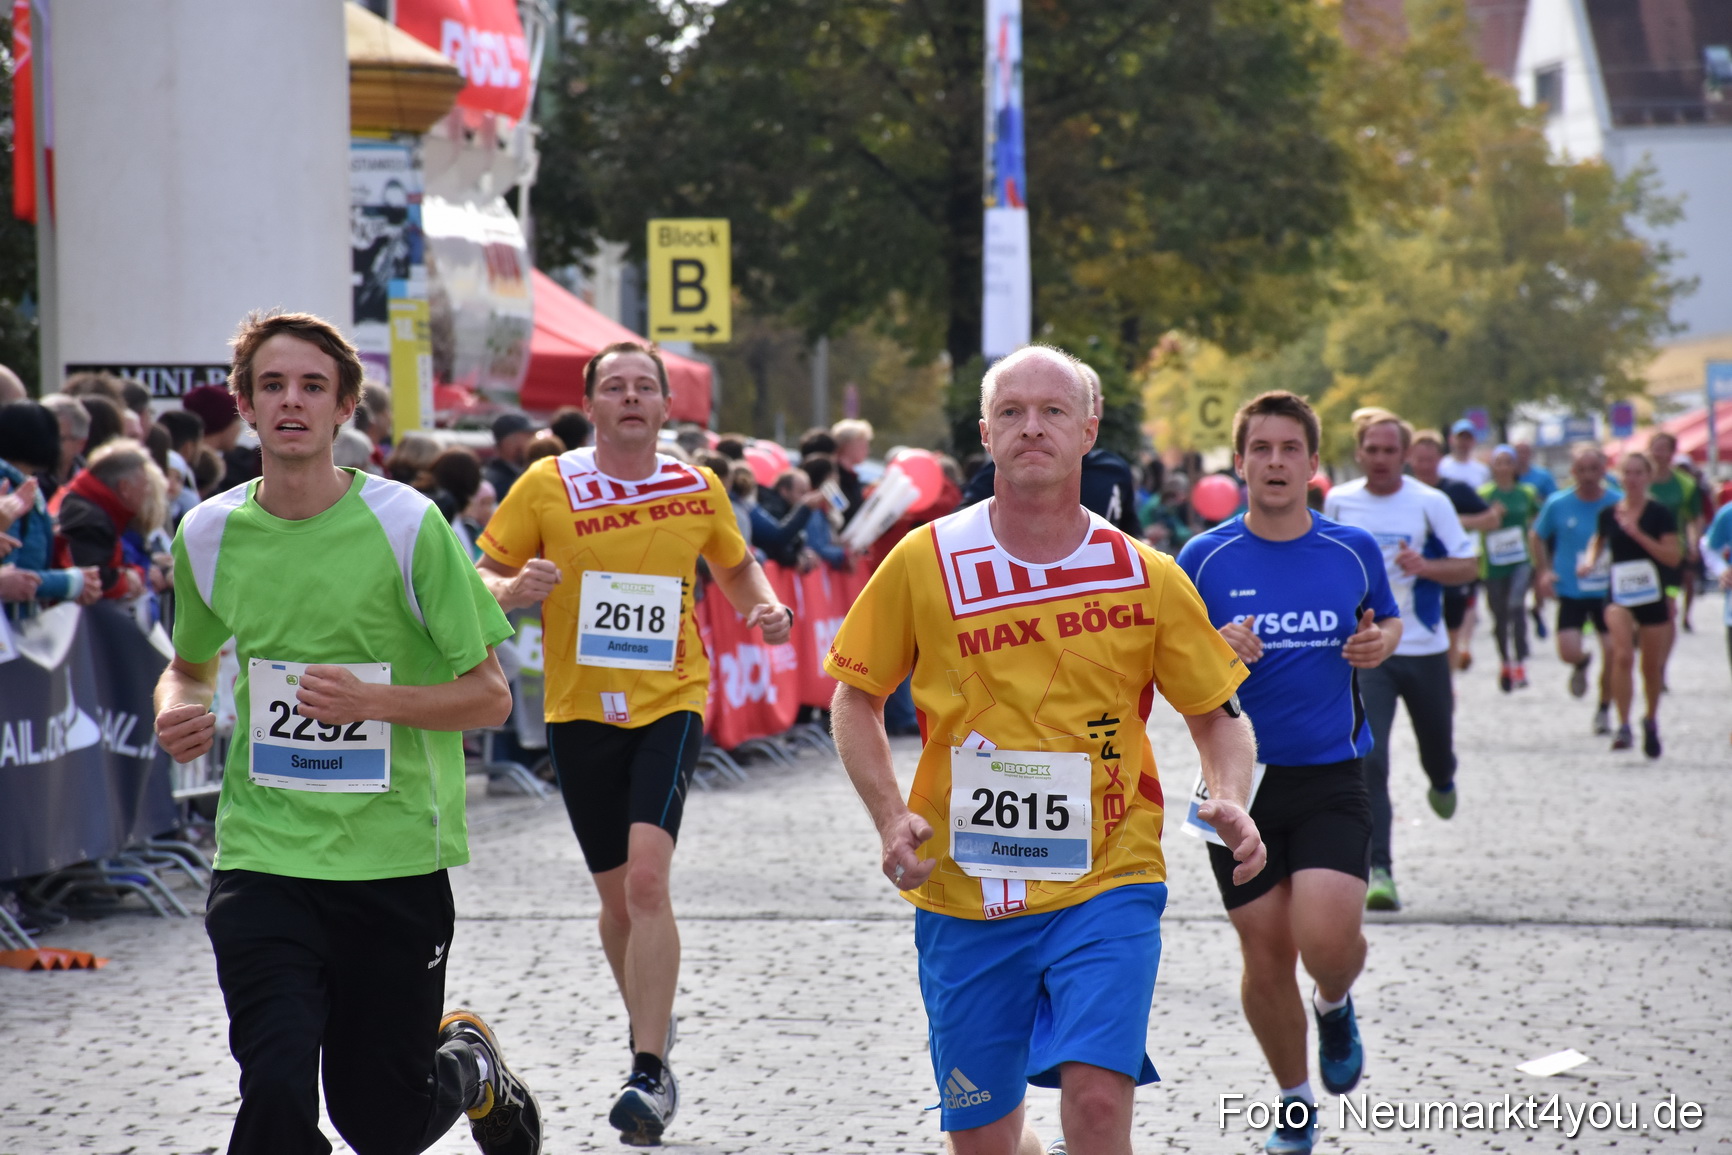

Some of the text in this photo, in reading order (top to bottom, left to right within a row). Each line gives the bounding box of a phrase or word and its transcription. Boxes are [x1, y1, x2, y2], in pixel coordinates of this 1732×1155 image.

[658, 226, 719, 248] Block
[671, 258, 709, 313] B
[1199, 394, 1223, 429] C
[574, 498, 715, 537] MAX BÖGL
[1238, 589, 1257, 597] JAKO
[594, 602, 665, 633] 2618
[957, 600, 1155, 658] MAX BÖGL
[607, 641, 649, 654] Andreas
[291, 754, 343, 770] Samuel
[1004, 762, 1051, 776] BOCK
[971, 788, 1070, 831] 2615
[957, 819, 963, 827] D
[991, 841, 1049, 858] Andreas
[943, 1090, 992, 1110] adidas
